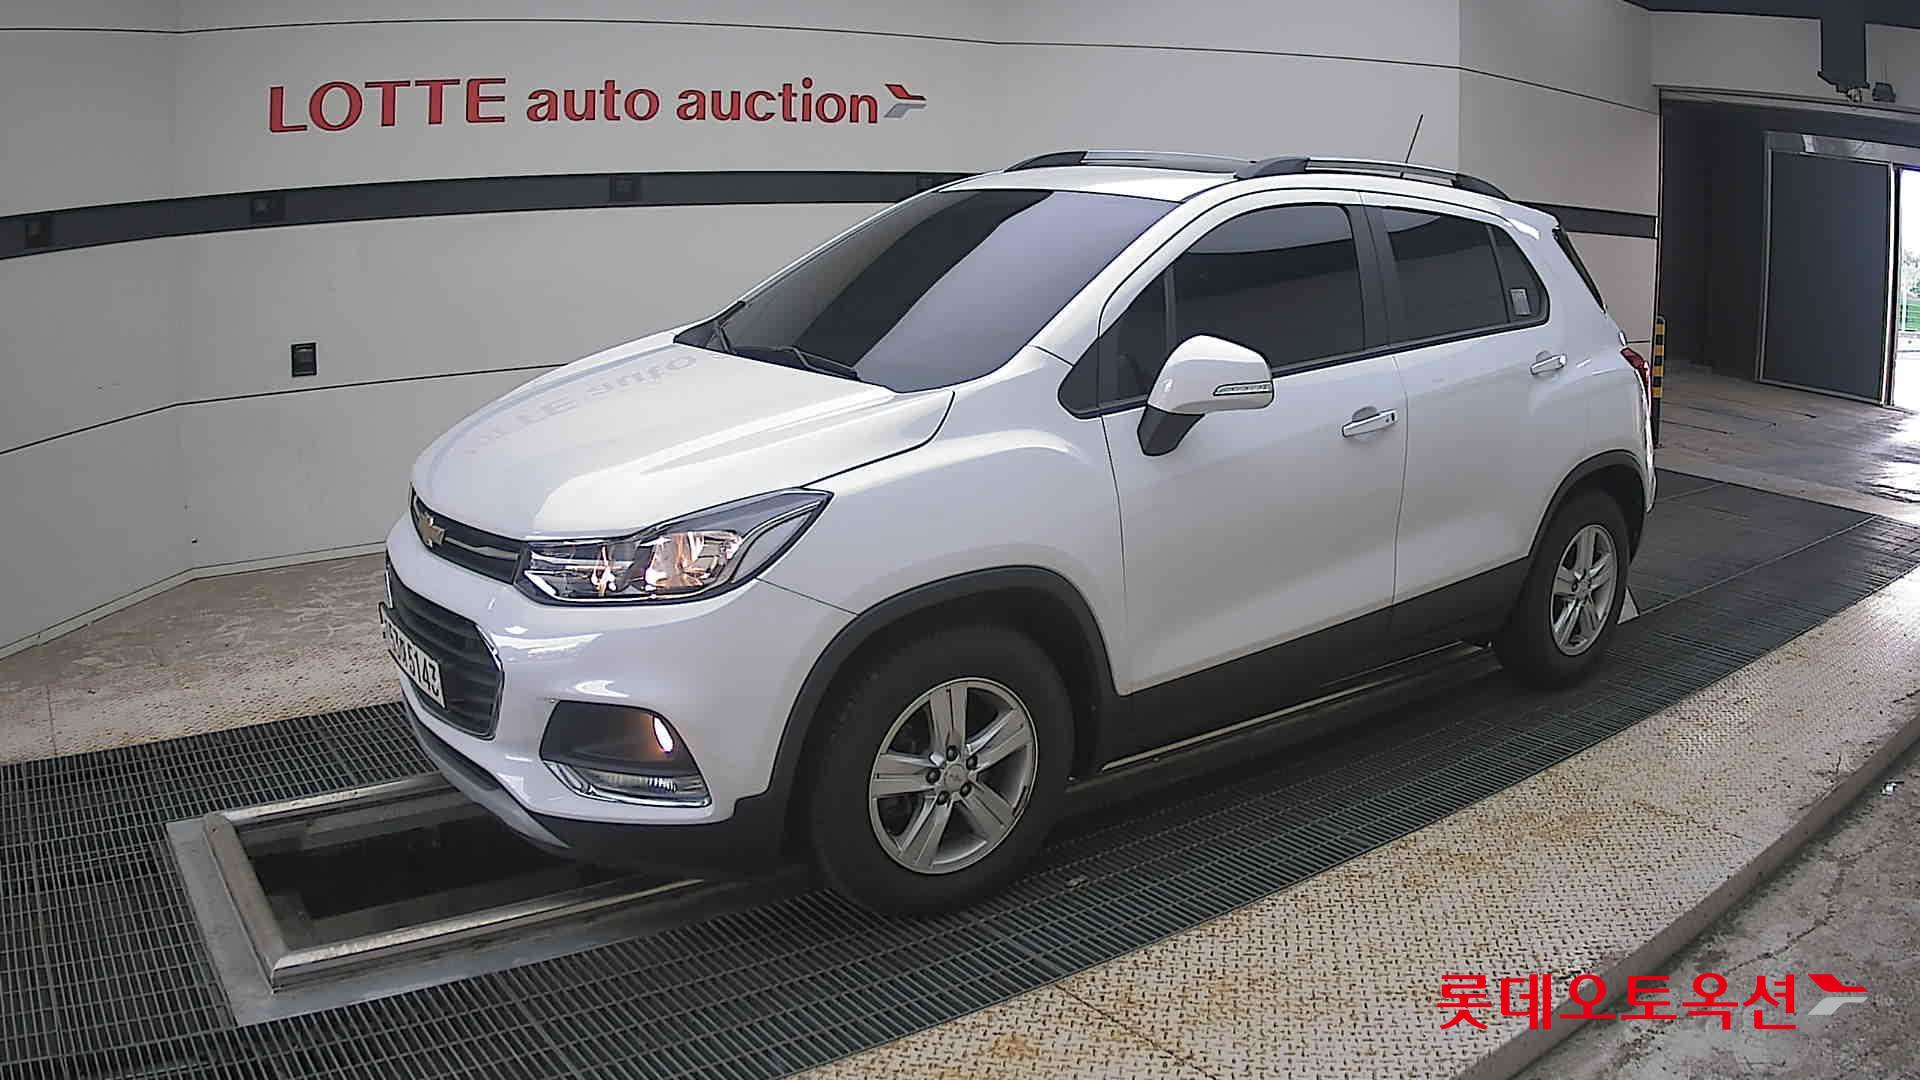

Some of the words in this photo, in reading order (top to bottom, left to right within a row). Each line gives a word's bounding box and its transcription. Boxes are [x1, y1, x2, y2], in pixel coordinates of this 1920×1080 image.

[269, 78, 506, 133] LOTTE
[526, 79, 660, 122] auto
[676, 77, 878, 124] auction
